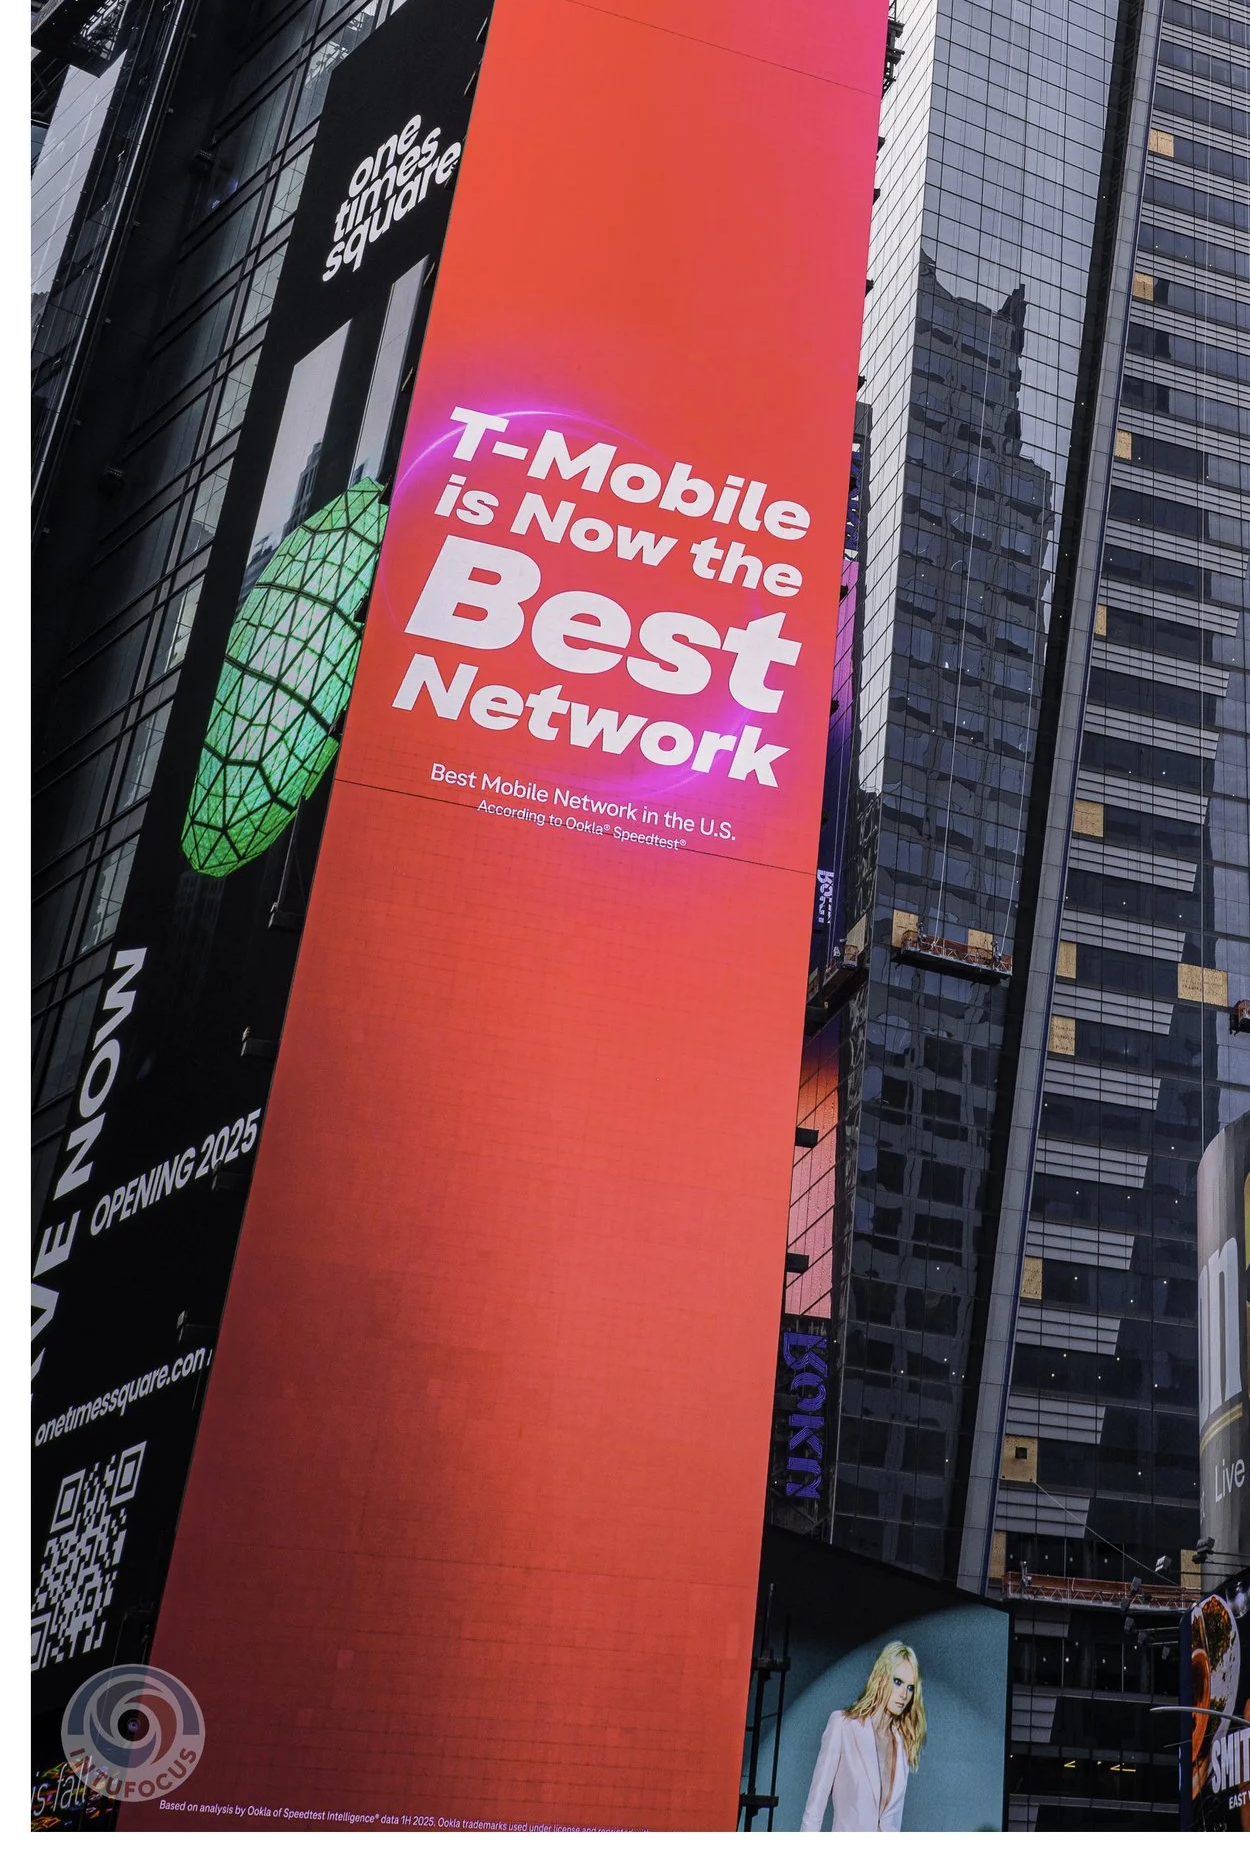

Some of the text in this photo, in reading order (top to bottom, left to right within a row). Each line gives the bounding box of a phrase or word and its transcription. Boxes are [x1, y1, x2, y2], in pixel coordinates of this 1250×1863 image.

[322, 141, 462, 282] square
[333, 127, 441, 242] times
[348, 114, 422, 198] one
[450, 406, 811, 540] T-Mobile
[434, 475, 803, 598] is Now the
[404, 534, 803, 714] Best
[392, 653, 790, 788] Network
[430, 763, 736, 841] Best Mobile Network in the U.S.
[477, 799, 545, 826] According
[549, 813, 563, 827] to
[31, 947, 148, 1383] VE NOW
[90, 1107, 262, 1237] OPENING 2025
[1215, 1458, 1245, 1503] Live
[160, 1799, 186, 1811] Based
[187, 1803, 198, 1812] on
[199, 1804, 234, 1816] analysis
[235, 1805, 246, 1817] by
[247, 1805, 271, 1817] Ookla
[273, 1808, 283, 1817] of
[283, 1808, 325, 1820] Speedtest
[380, 1814, 399, 1825] data
[400, 1815, 412, 1825] 1H
[413, 1815, 436, 1827] 2025.
[437, 1817, 460, 1828] Ookla
[462, 1819, 507, 1831] trademarks
[508, 1822, 528, 1832] used
[528, 1823, 551, 1832] under
[1229, 1792, 1247, 1810] EAST
